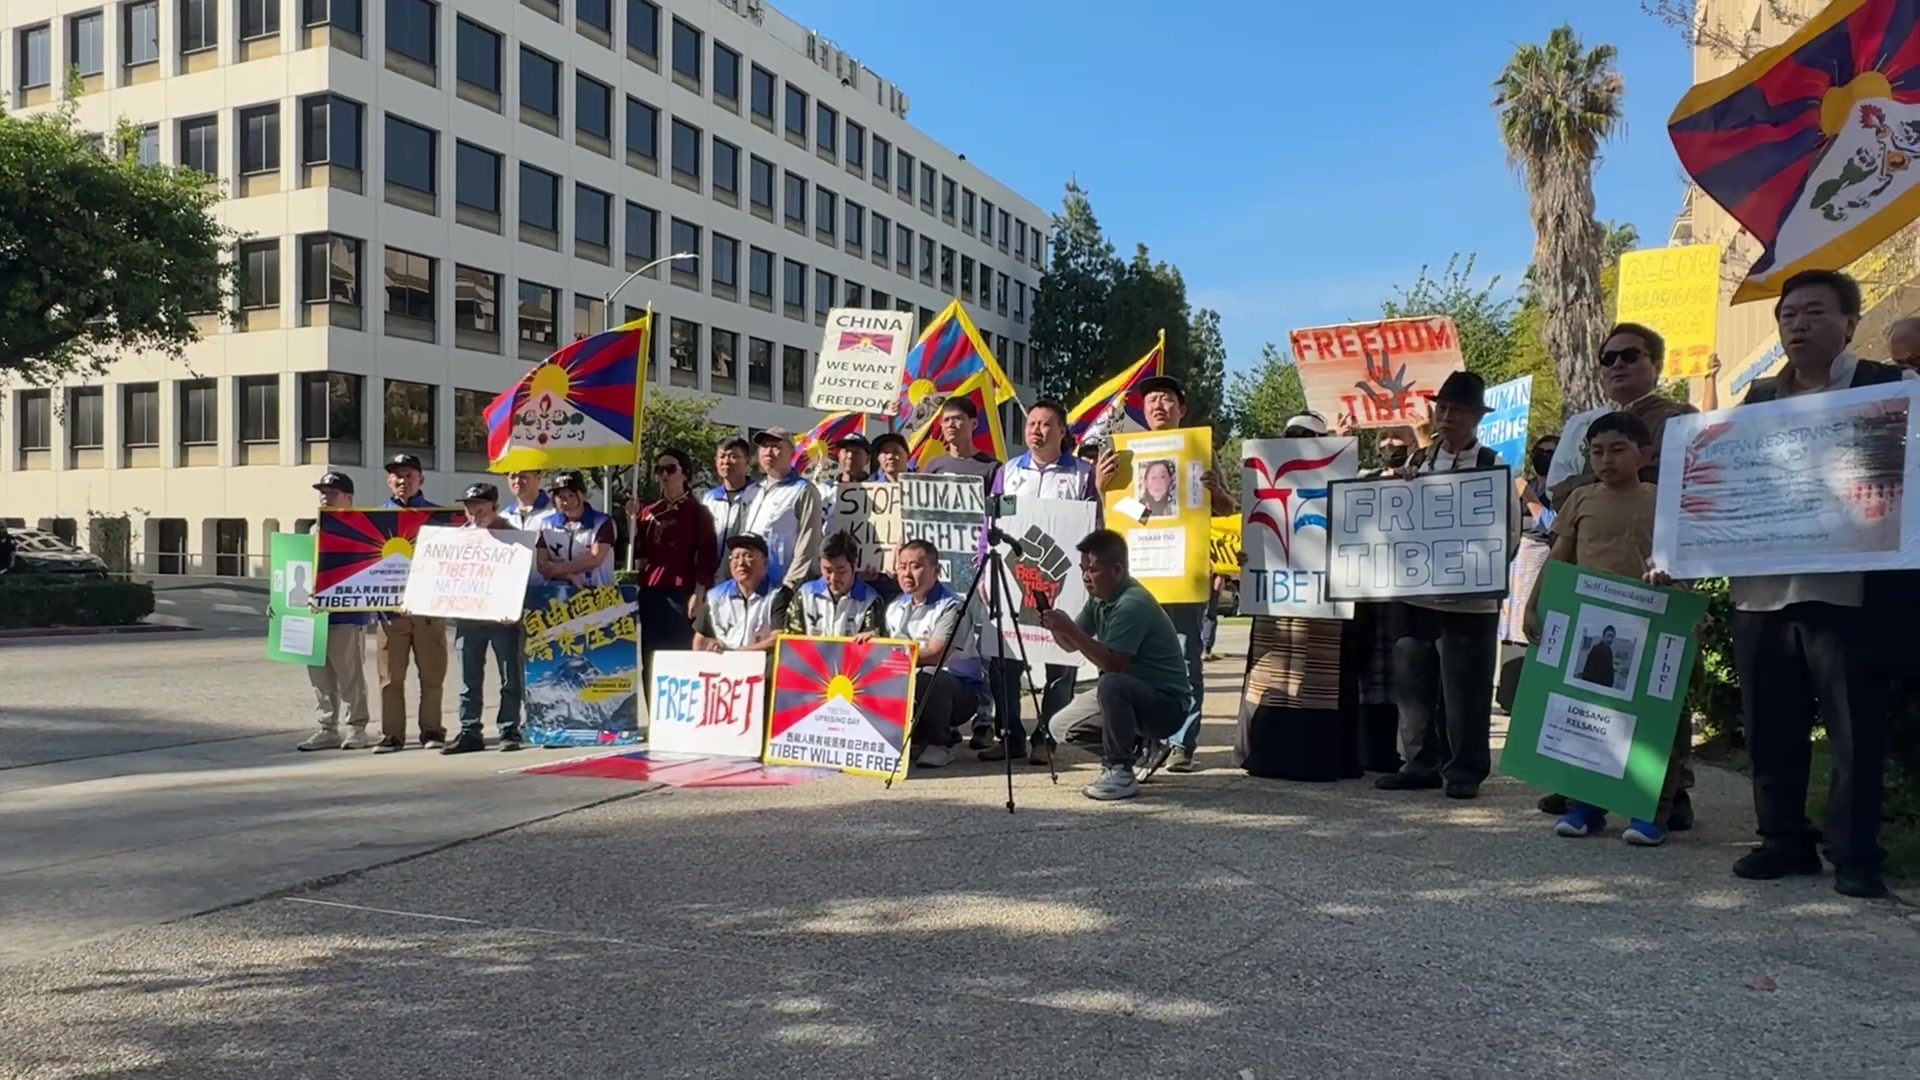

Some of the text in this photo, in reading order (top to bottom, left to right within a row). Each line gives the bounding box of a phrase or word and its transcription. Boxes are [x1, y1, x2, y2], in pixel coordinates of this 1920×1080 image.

[1624, 249, 1717, 285] ALLOW
[836, 315, 903, 331] CHINA
[1293, 320, 1450, 361] FREEDOM
[826, 361, 897, 374] WE WANT
[819, 376, 894, 390] JUSTICE &
[1479, 416, 1527, 446] RIGHTS
[900, 480, 984, 512] HUMAN
[1343, 477, 1496, 534] FREE
[422, 542, 519, 566] ANNIVERSARY
[1338, 538, 1502, 589] TIBET
[438, 561, 496, 579] TIBETAN
[1014, 563, 1041, 580] FREE
[315, 595, 361, 608] TIBET
[1583, 578, 1655, 605] Self-Immolated
[1547, 624, 1562, 655] For
[1658, 636, 1677, 694] Tibet
[656, 675, 701, 722] FREE
[815, 714, 861, 725] UPRISING DAY
[1566, 717, 1607, 736] KELSANG
[1568, 705, 1612, 724] LOBSANG
[770, 743, 903, 773] TIBET WILL BE FREE
